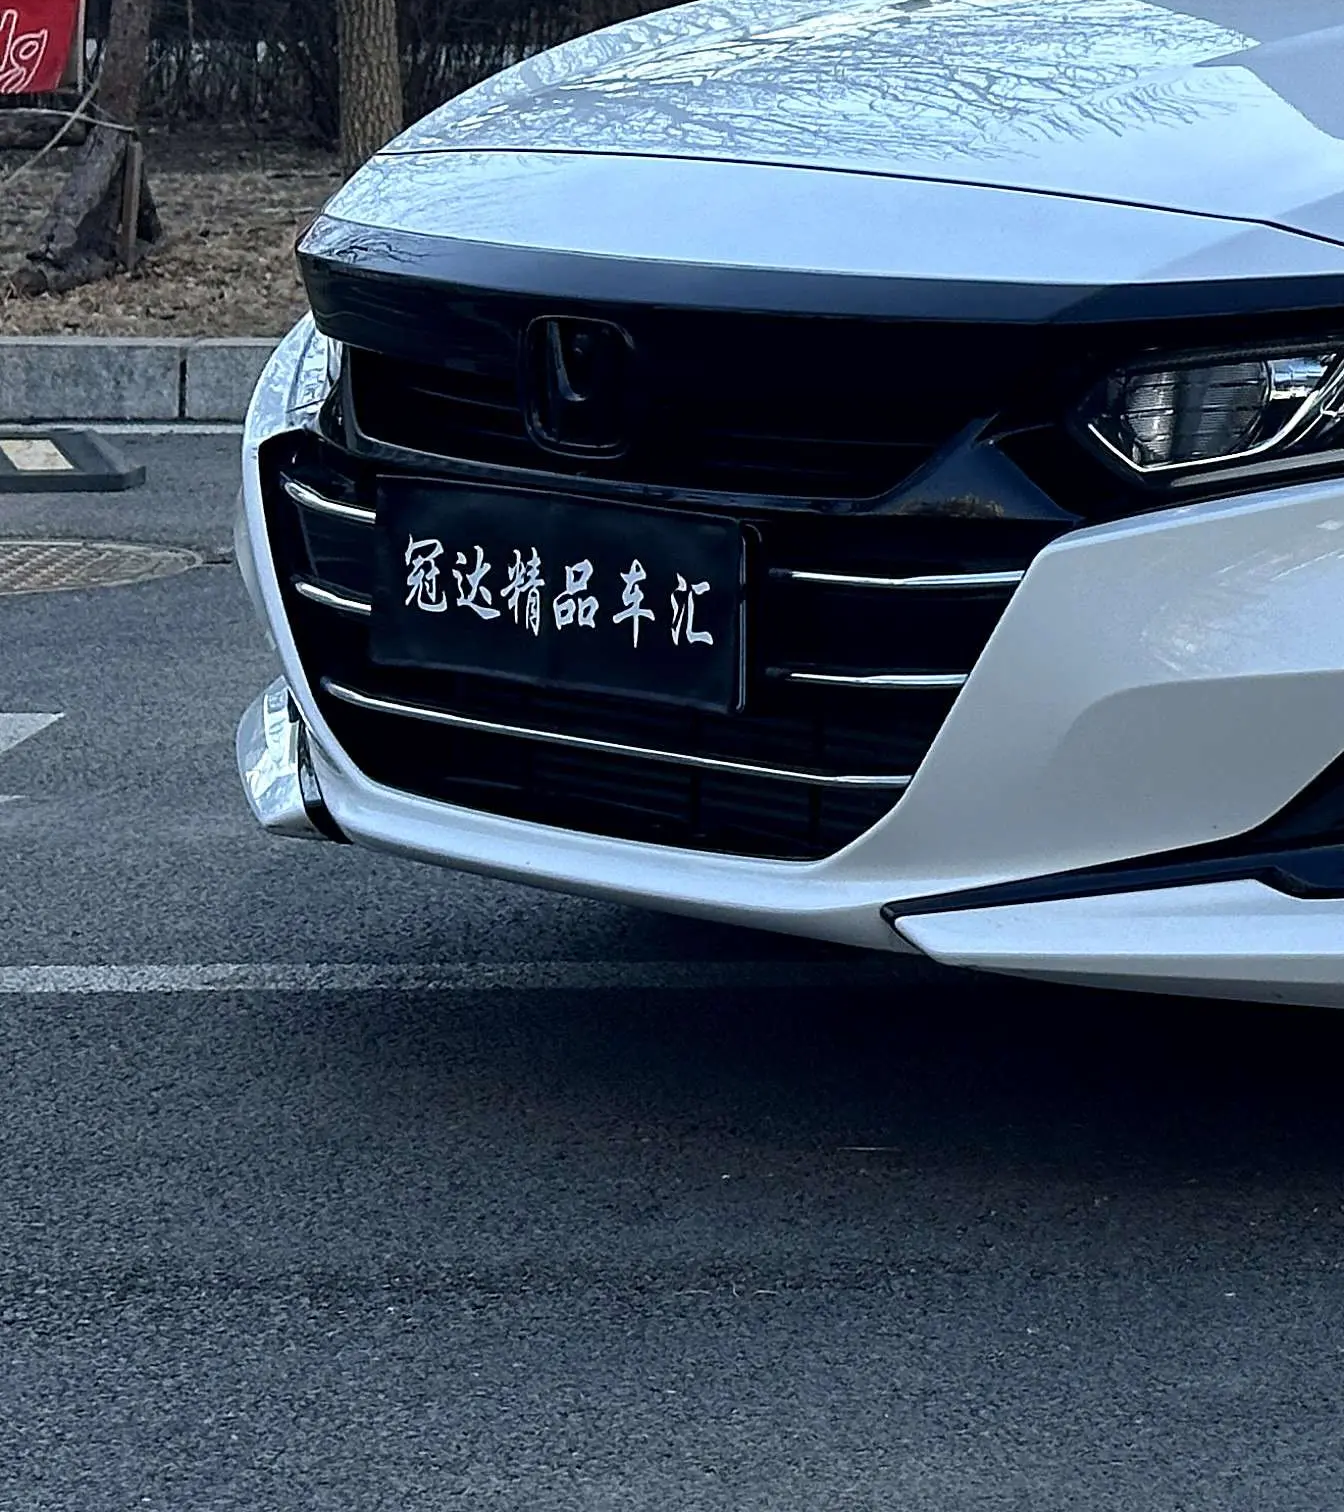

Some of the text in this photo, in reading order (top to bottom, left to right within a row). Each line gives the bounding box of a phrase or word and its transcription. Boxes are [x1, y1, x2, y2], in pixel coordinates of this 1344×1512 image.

[404, 533, 714, 649] 冠达精品车汇
